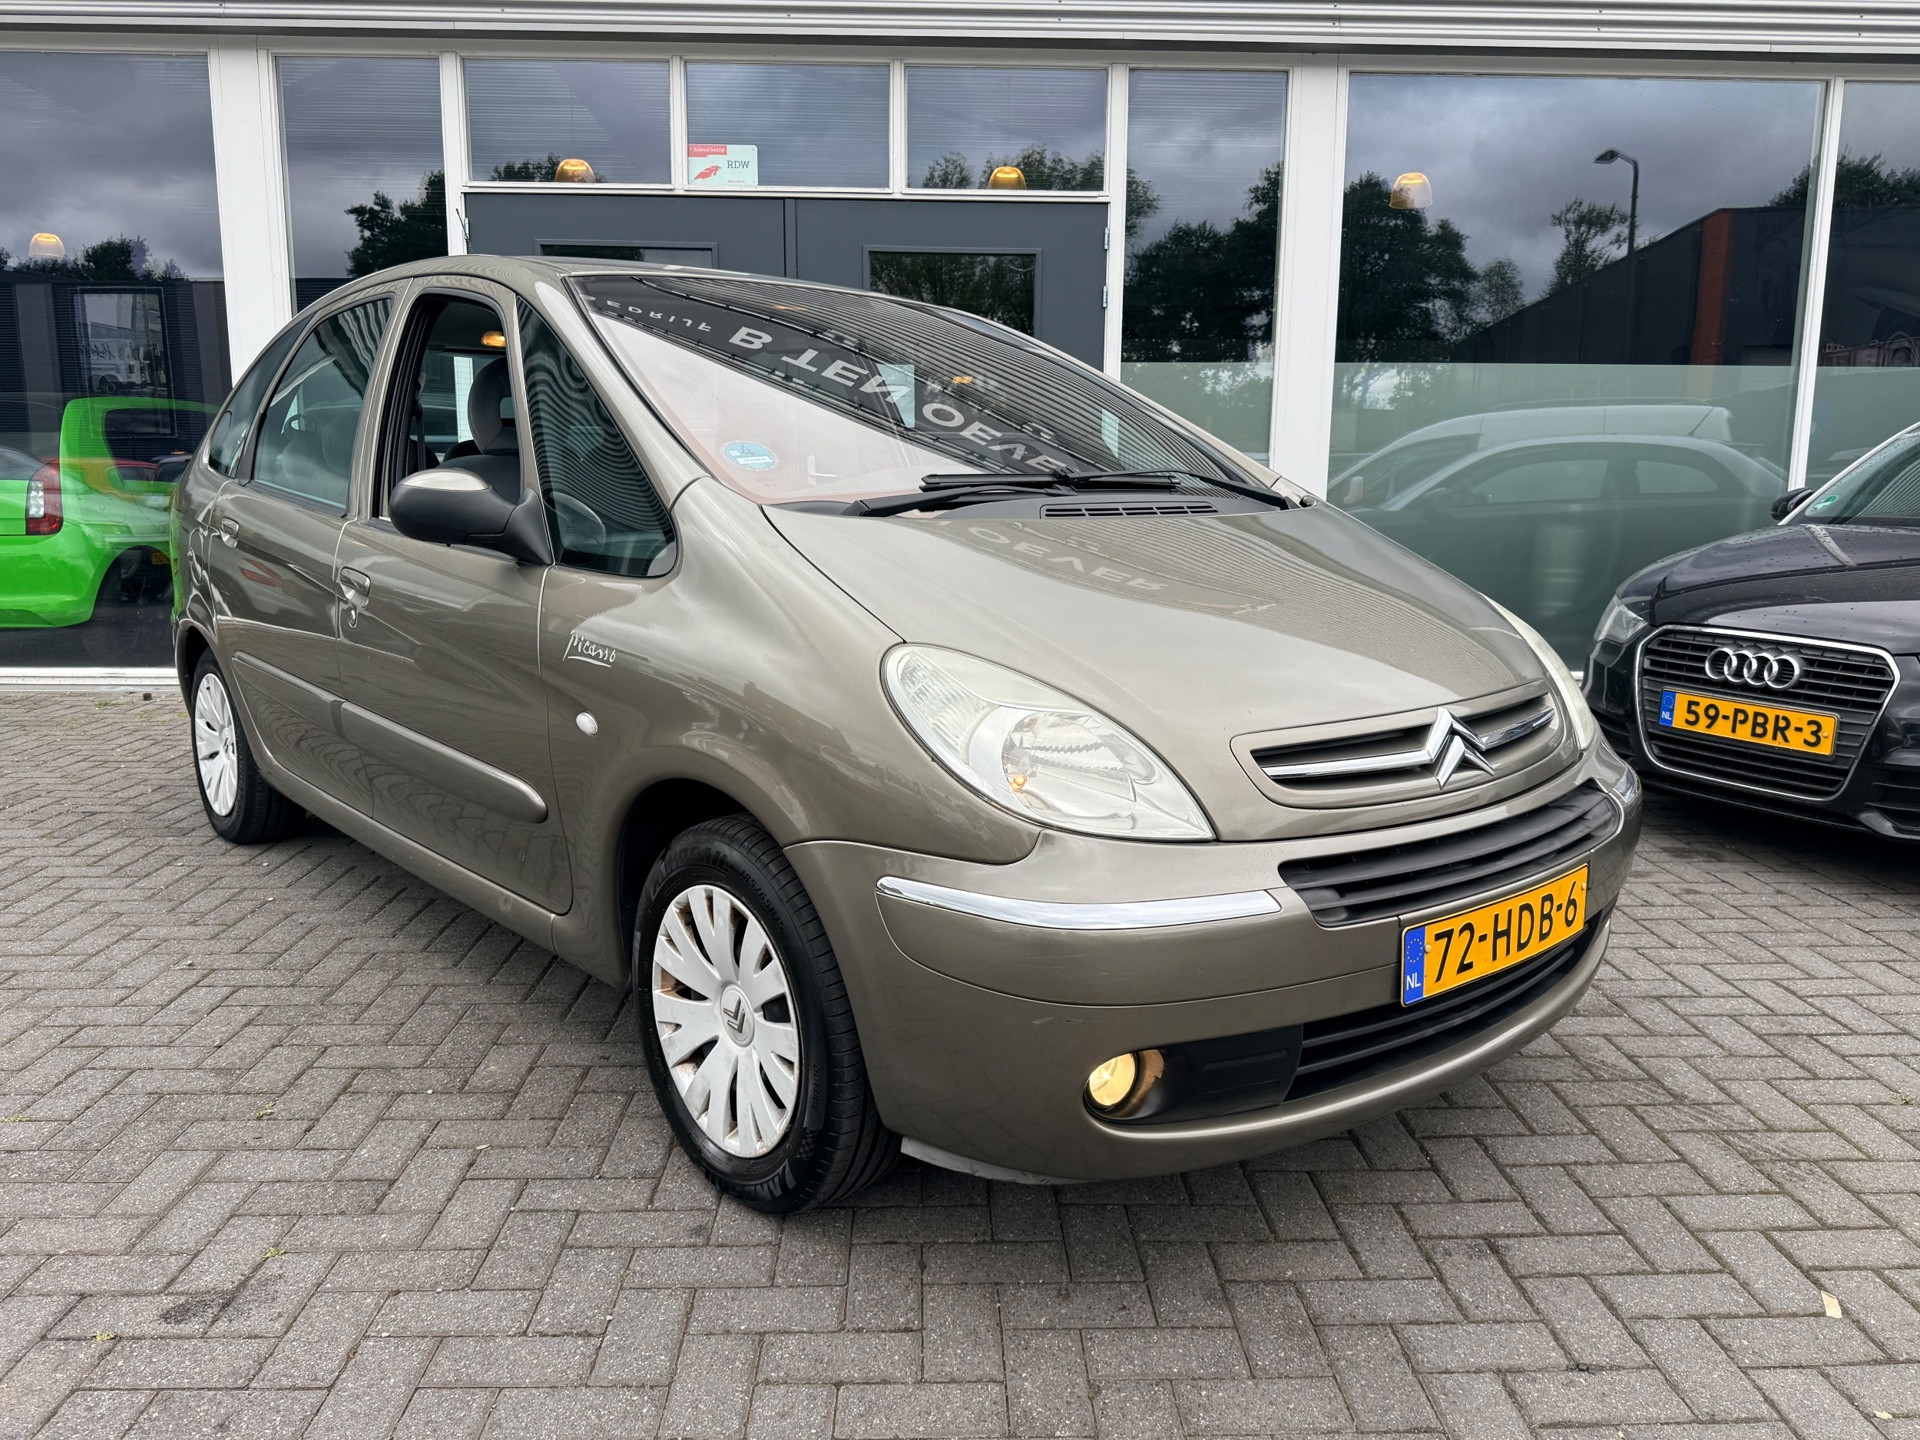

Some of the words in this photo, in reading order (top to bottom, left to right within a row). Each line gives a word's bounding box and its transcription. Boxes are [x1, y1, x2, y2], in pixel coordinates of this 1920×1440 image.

[727, 160, 750, 169] RDW
[563, 629, 616, 664] Picasso
[1661, 710, 1672, 721] NL
[1685, 699, 1823, 748] 59-PBR-3
[1434, 880, 1578, 983] 72-HDB-6
[1406, 972, 1421, 991] NL
